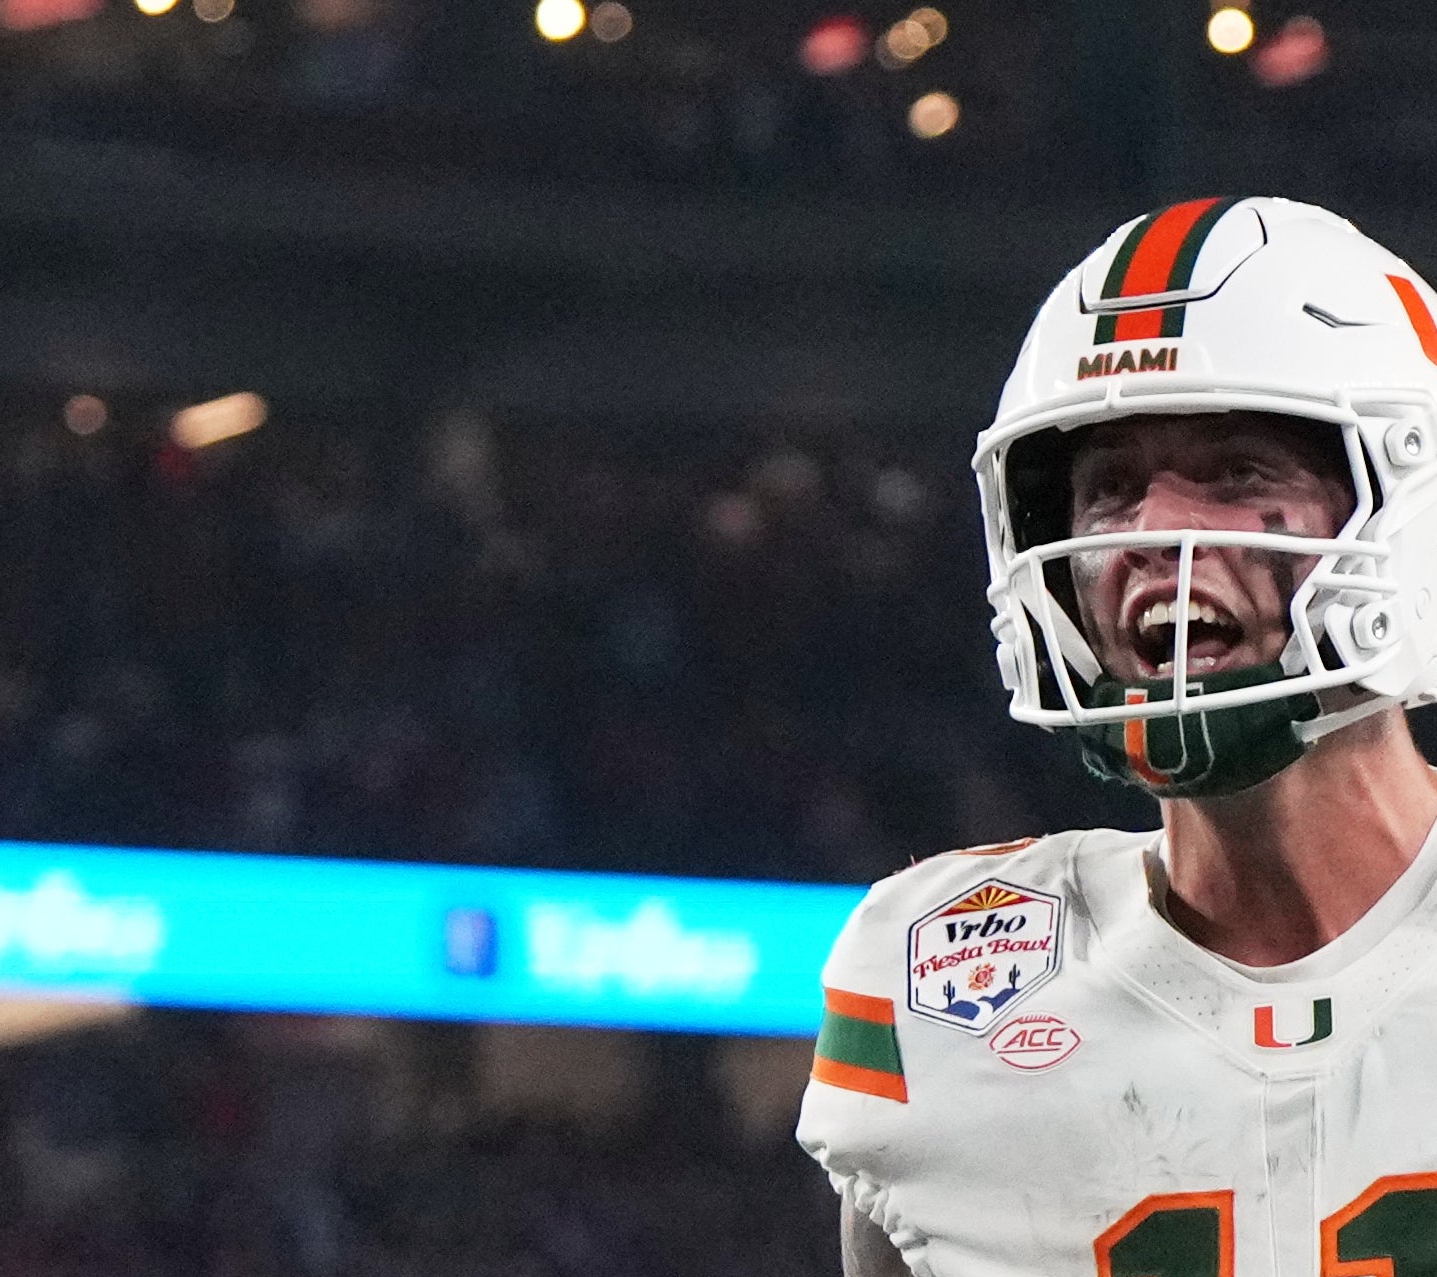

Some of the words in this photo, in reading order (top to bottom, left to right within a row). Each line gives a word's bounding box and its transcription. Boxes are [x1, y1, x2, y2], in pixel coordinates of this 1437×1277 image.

[1076, 347, 1179, 381] MIAMI
[945, 913, 1026, 942] Vrbo
[913, 944, 984, 980] Fiesta
[987, 935, 1052, 956] Bowl
[1003, 1028, 1066, 1048] ACC
[1253, 997, 1333, 1048] U
